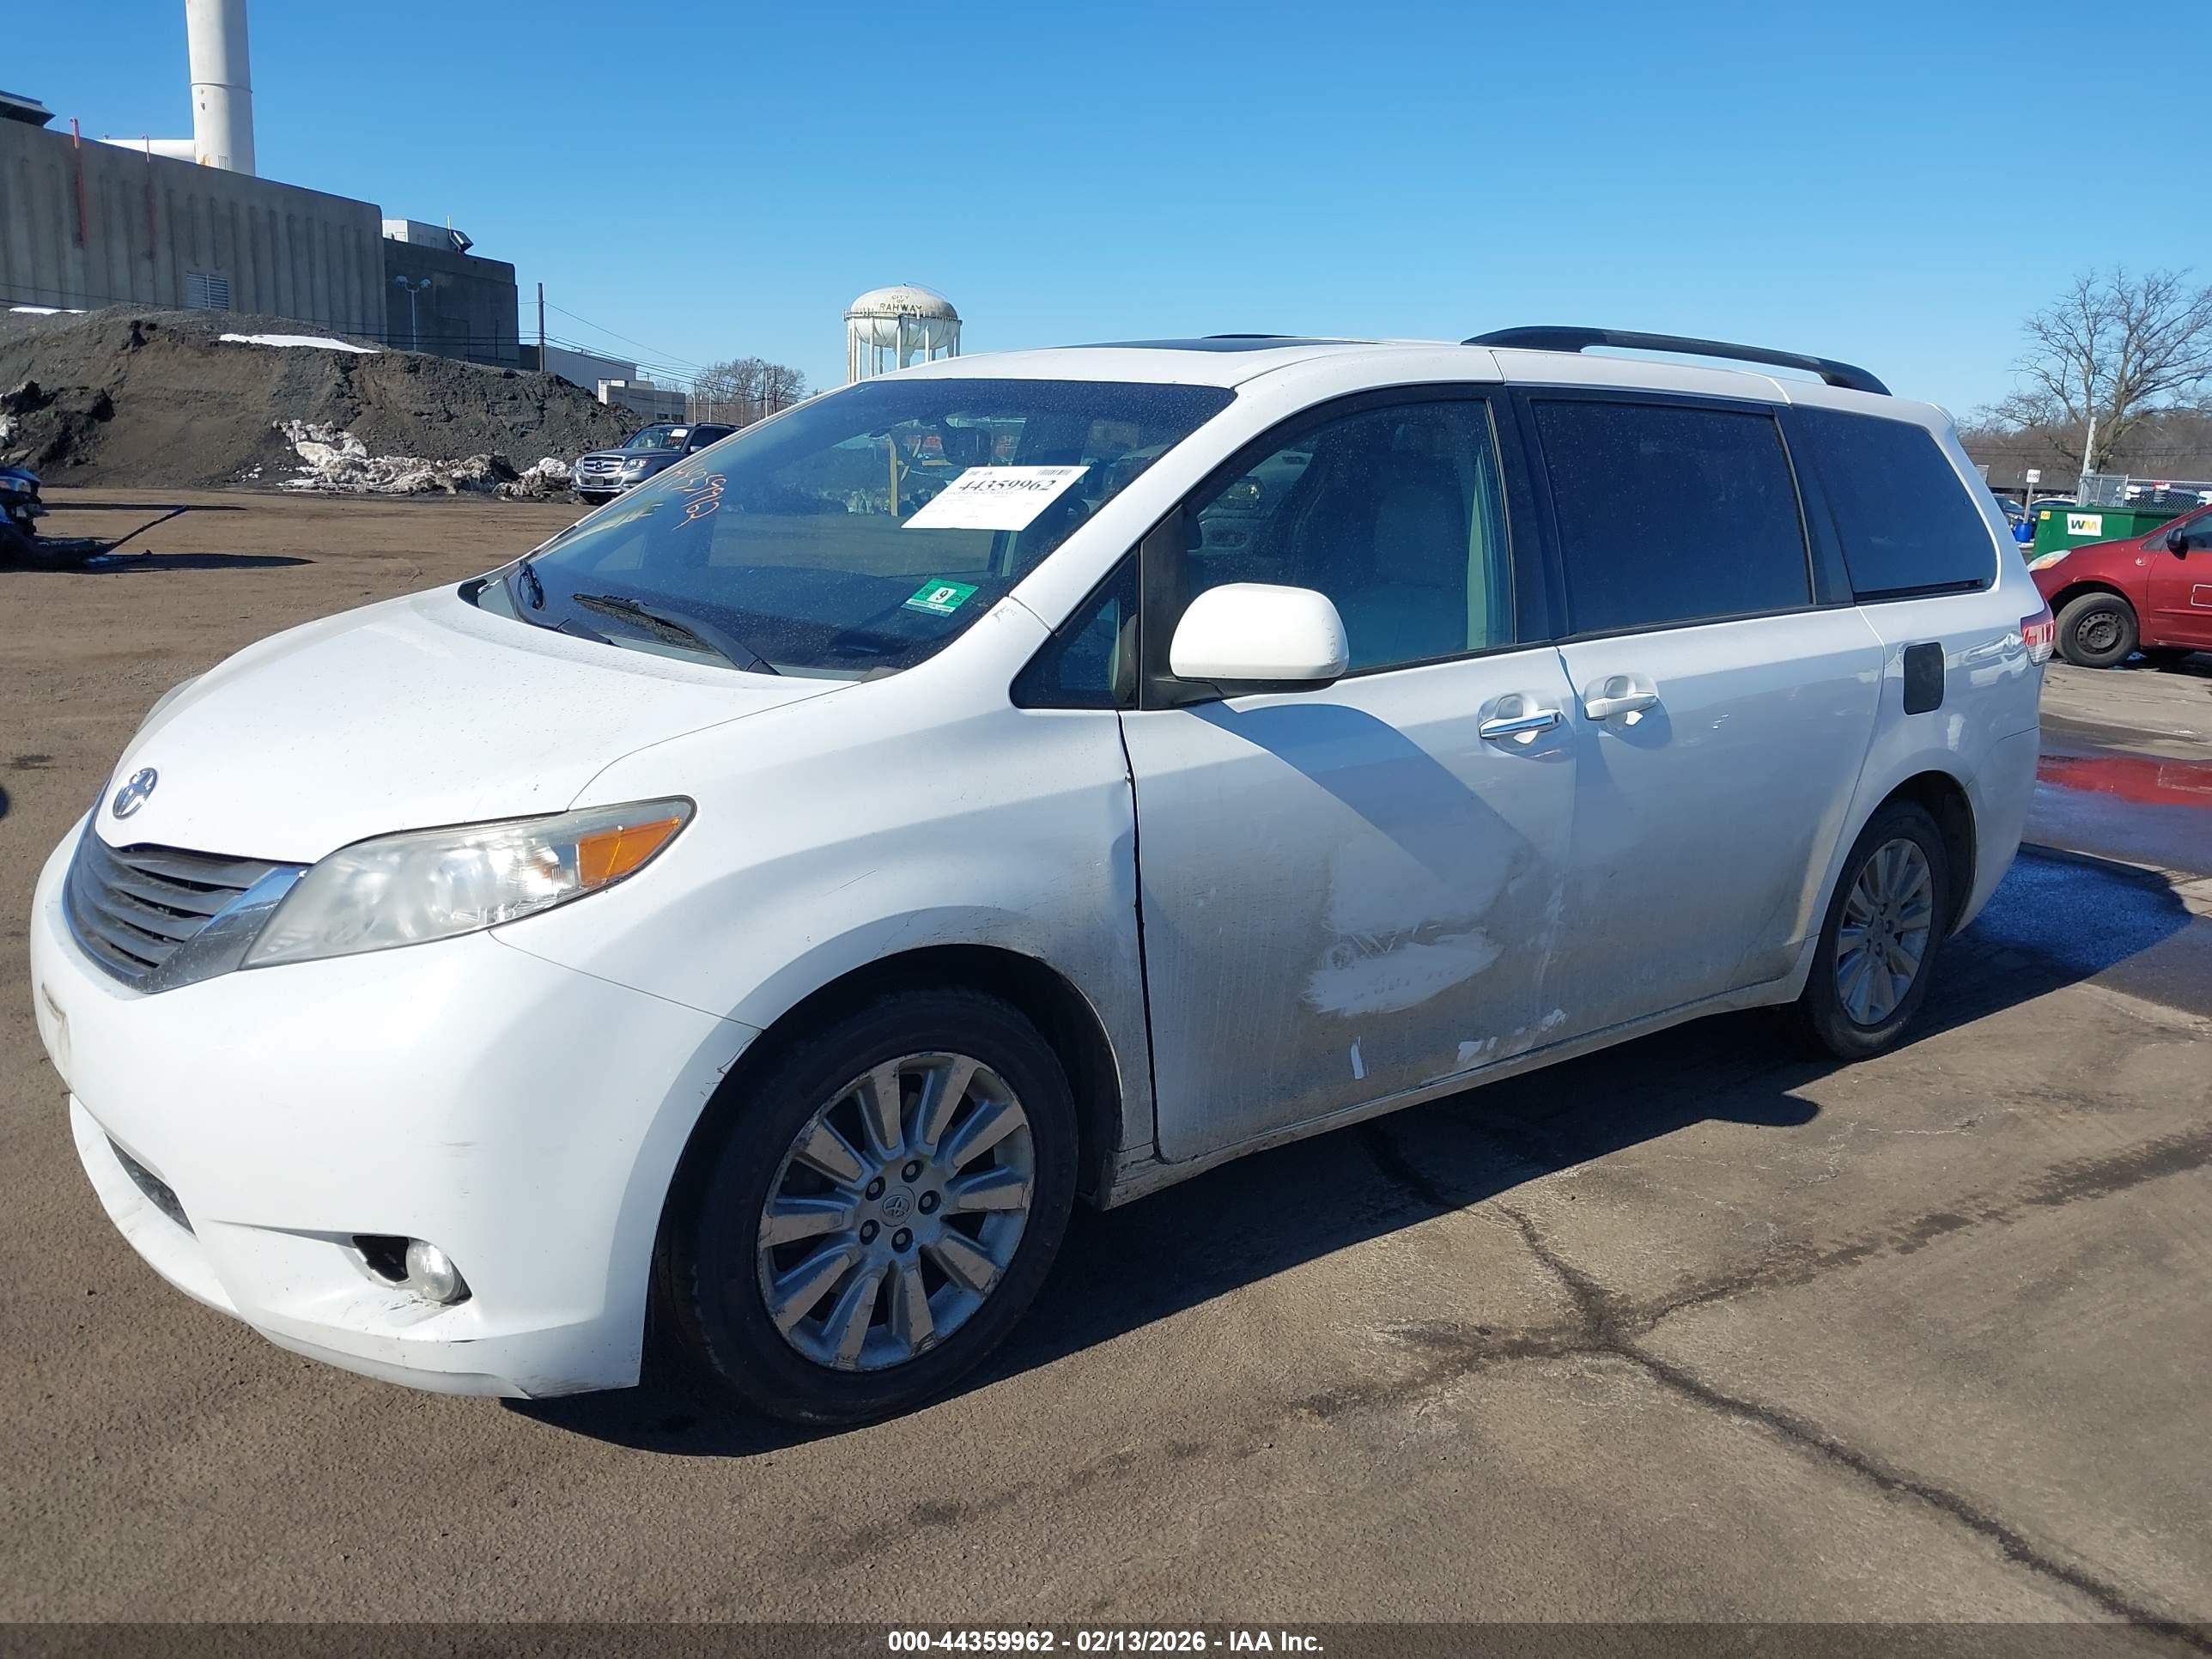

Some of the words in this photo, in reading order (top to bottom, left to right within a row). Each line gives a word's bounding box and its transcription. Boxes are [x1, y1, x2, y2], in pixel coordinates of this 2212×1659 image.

[879, 302, 922, 312] RAHWAY
[958, 478, 1057, 492] 44359962
[2071, 519, 2098, 531] WM
[935, 589, 950, 601] 9
